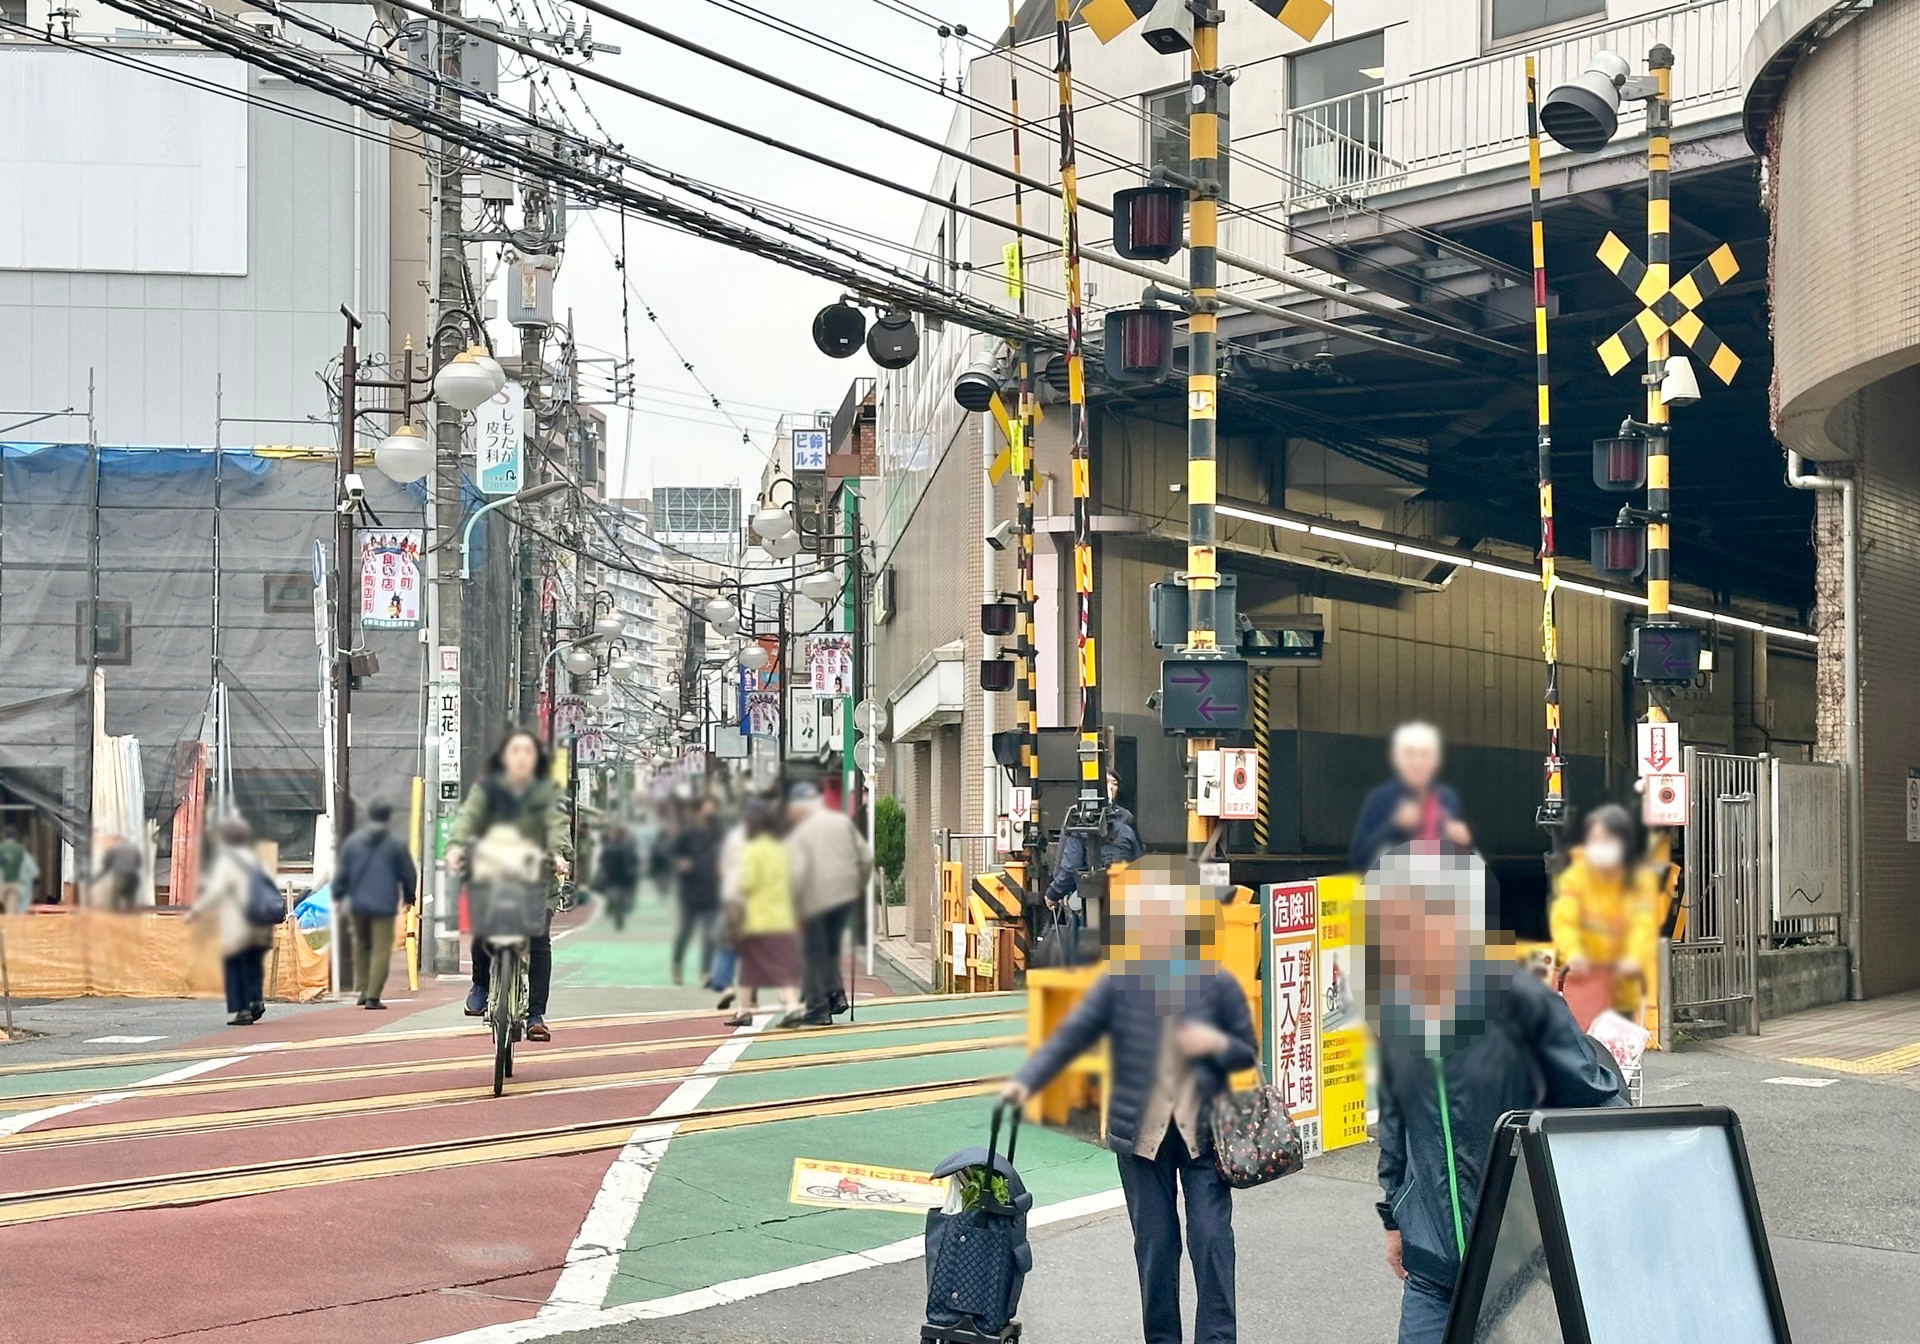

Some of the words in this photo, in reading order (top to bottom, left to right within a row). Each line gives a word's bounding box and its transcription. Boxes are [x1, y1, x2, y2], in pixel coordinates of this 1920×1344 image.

[485, 421, 500, 463] 皮フ科
[796, 433, 808, 467] ビル
[809, 433, 824, 468] 鈴木
[441, 693, 455, 733] 立花
[1274, 892, 1315, 928] 危険!!
[1280, 950, 1297, 1110] 立入禁止
[1298, 949, 1314, 1104] 踏切警報時
